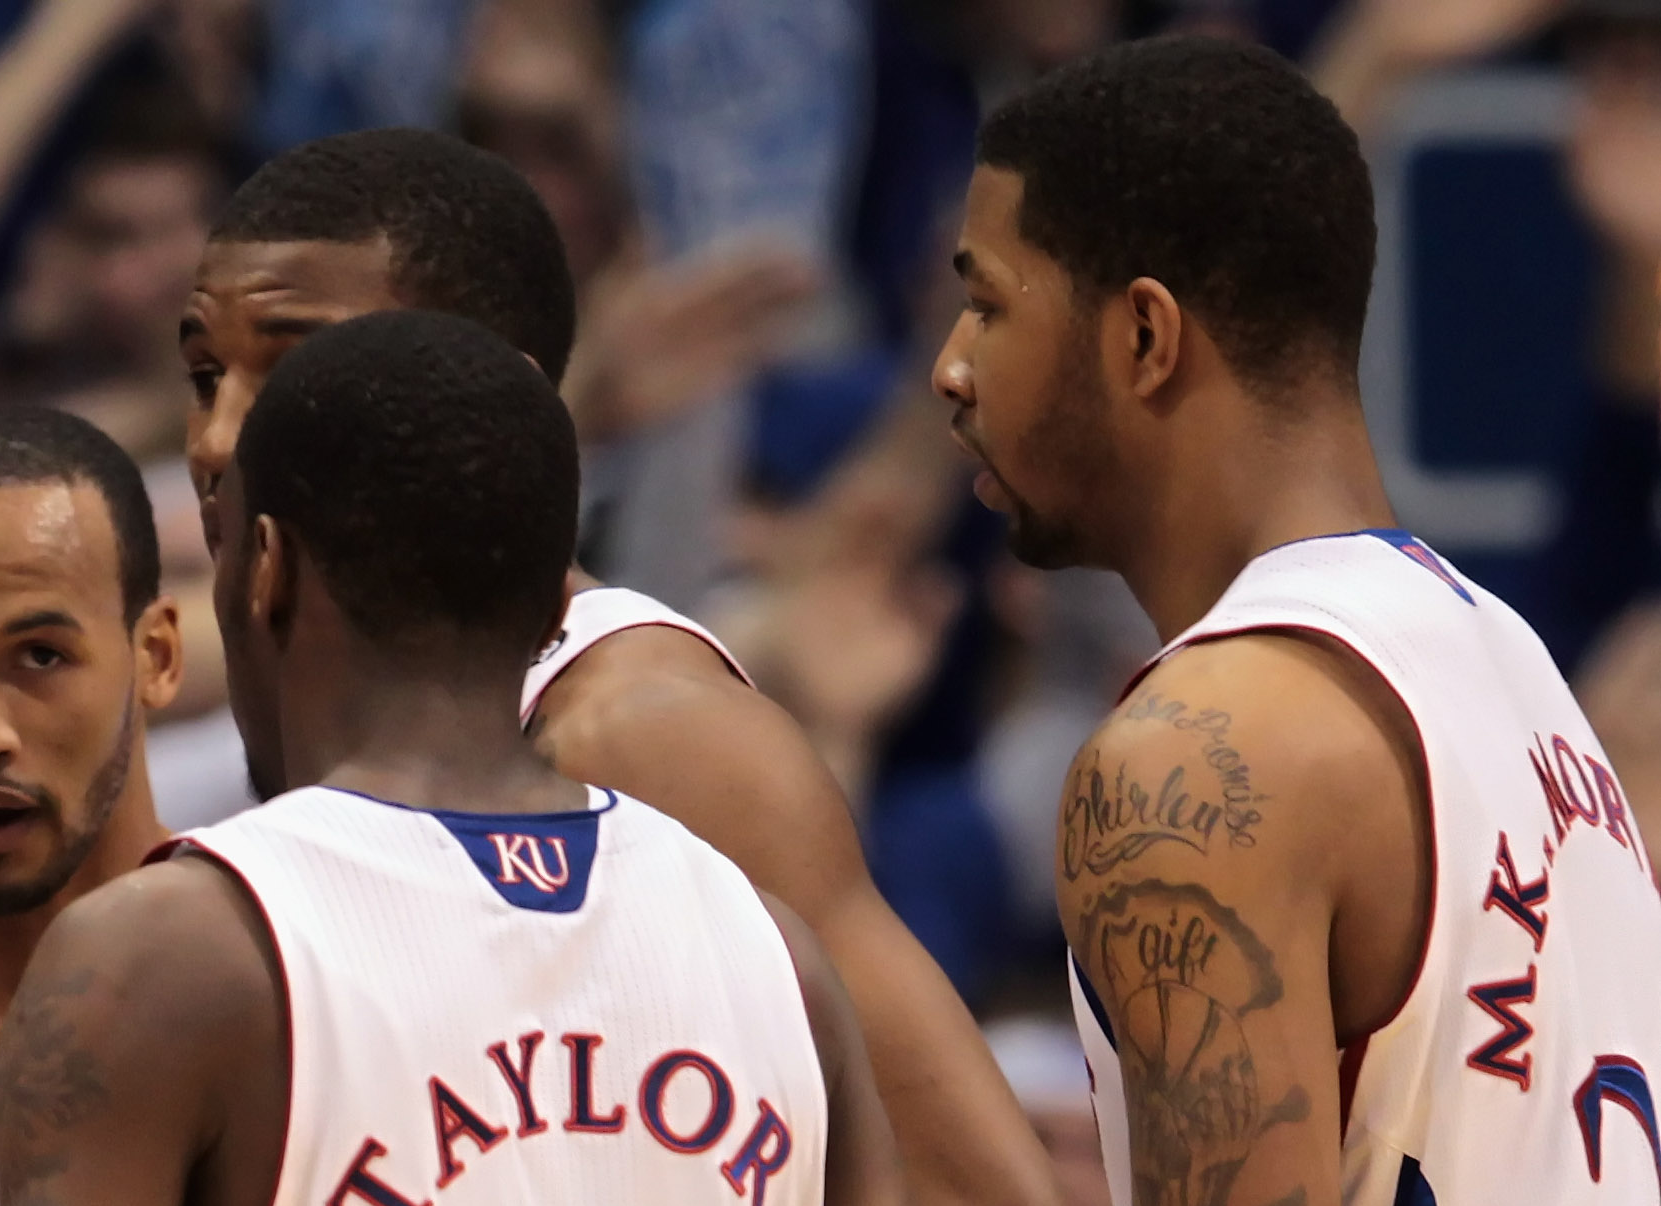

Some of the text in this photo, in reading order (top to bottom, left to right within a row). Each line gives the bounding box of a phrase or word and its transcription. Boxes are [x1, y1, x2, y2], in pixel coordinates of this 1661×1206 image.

[1063, 750, 1223, 883] Shirley
[489, 833, 568, 892] KU
[1139, 908, 1217, 988] gift
